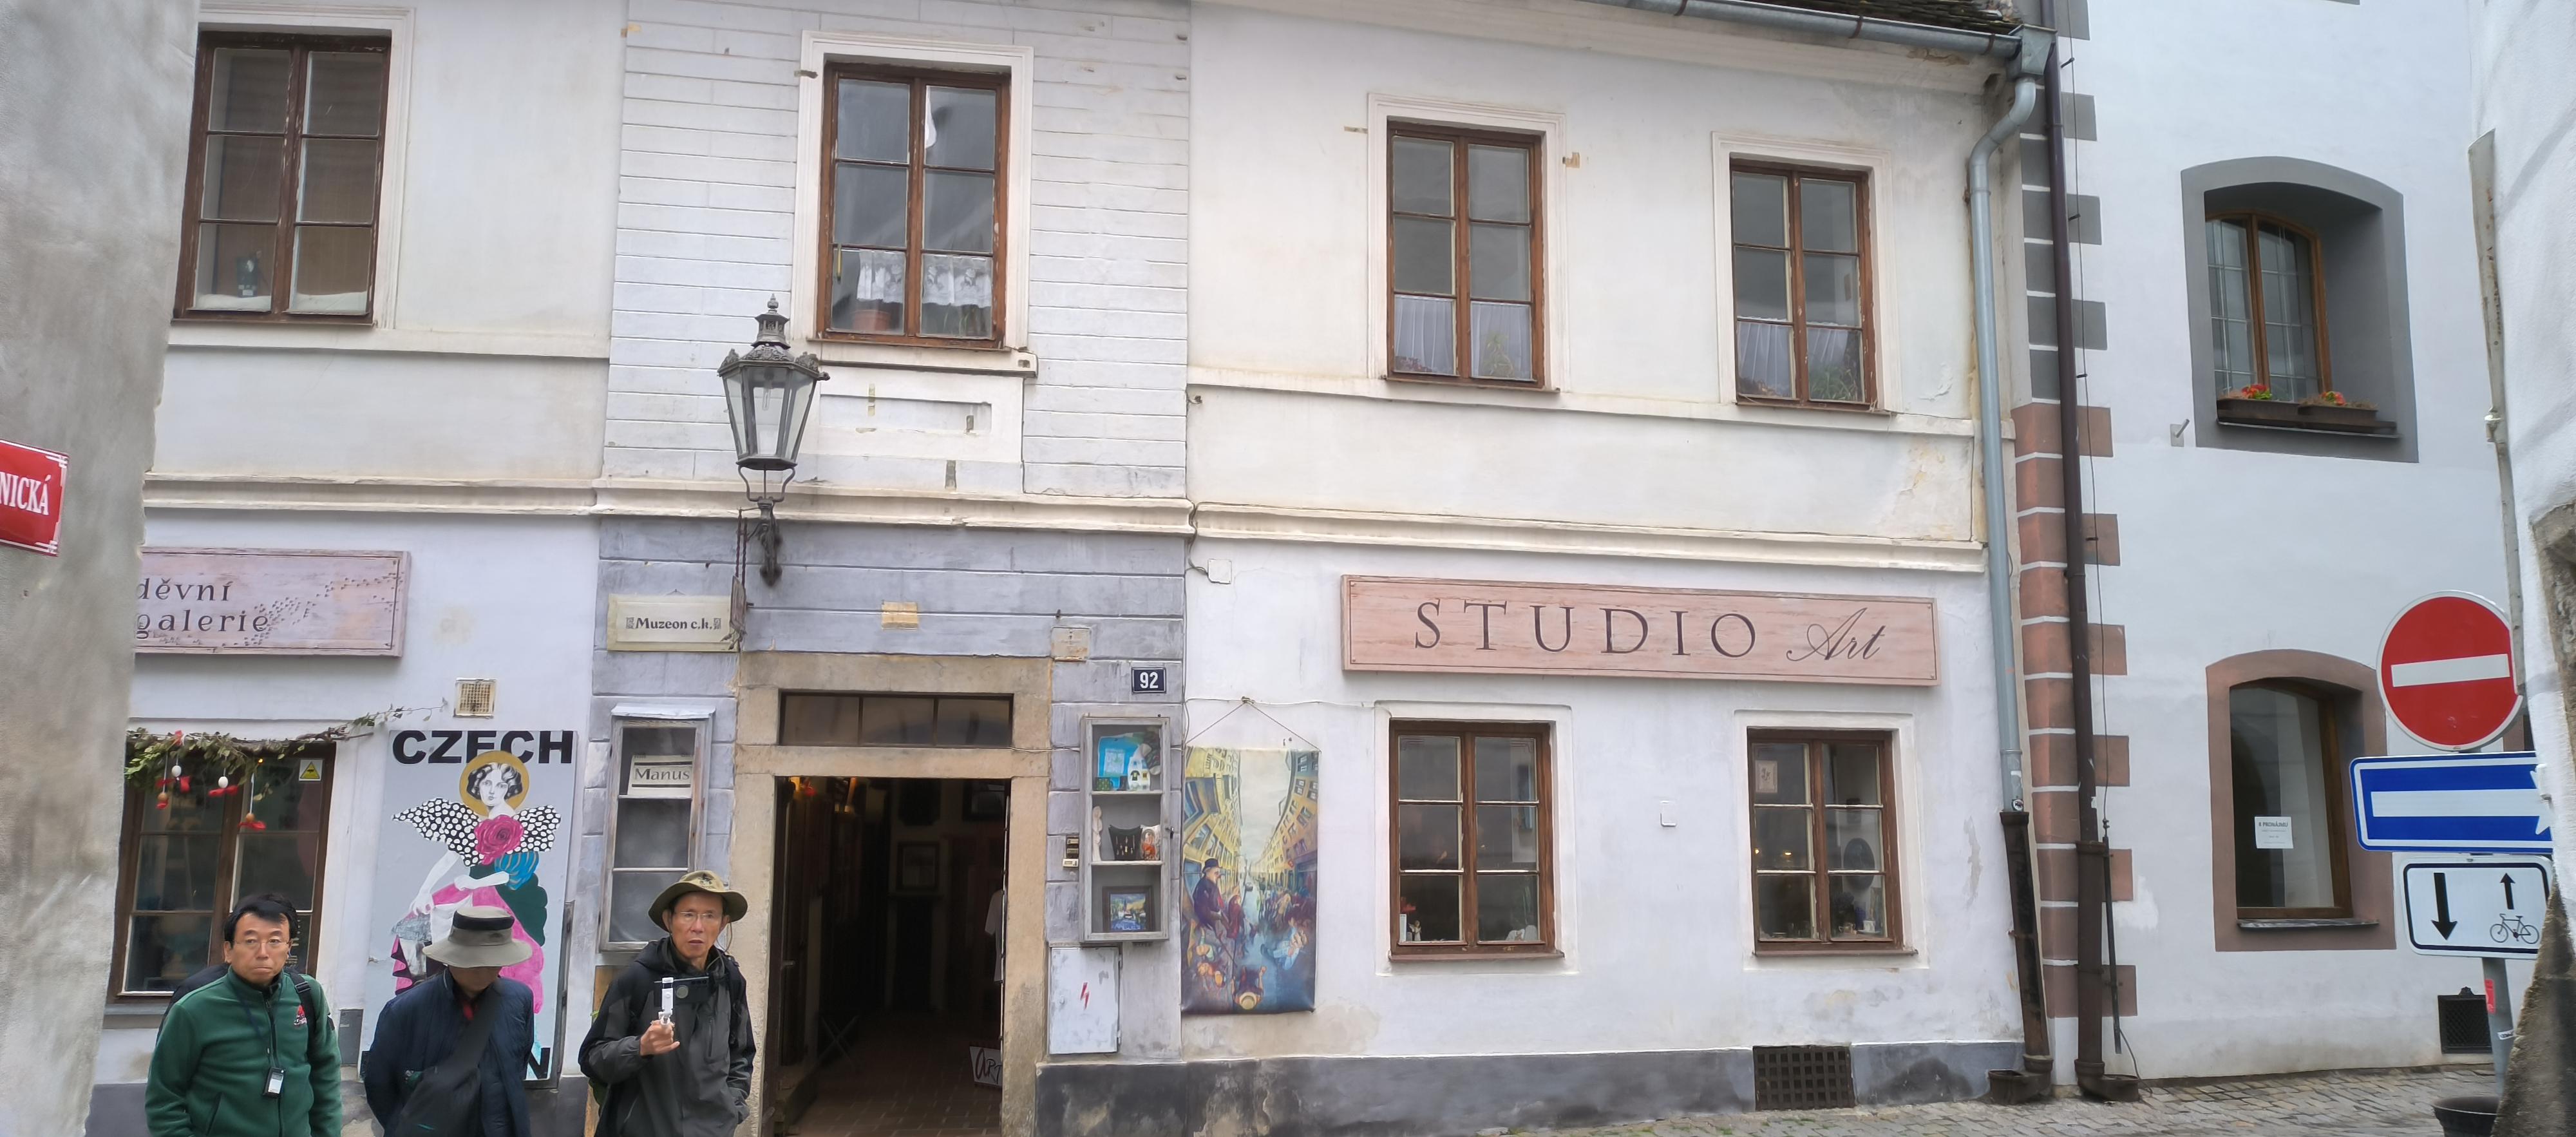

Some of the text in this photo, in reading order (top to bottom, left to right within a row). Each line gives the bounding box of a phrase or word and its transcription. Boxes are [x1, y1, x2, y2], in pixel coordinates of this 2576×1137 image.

[135, 609, 269, 640] galerie
[635, 617, 712, 629] Muzeon c.k.
[1415, 598, 1886, 662] STUDIO Art
[1139, 671, 1159, 689] 92
[392, 730, 573, 765] CZECH
[635, 767, 690, 780] Manus
